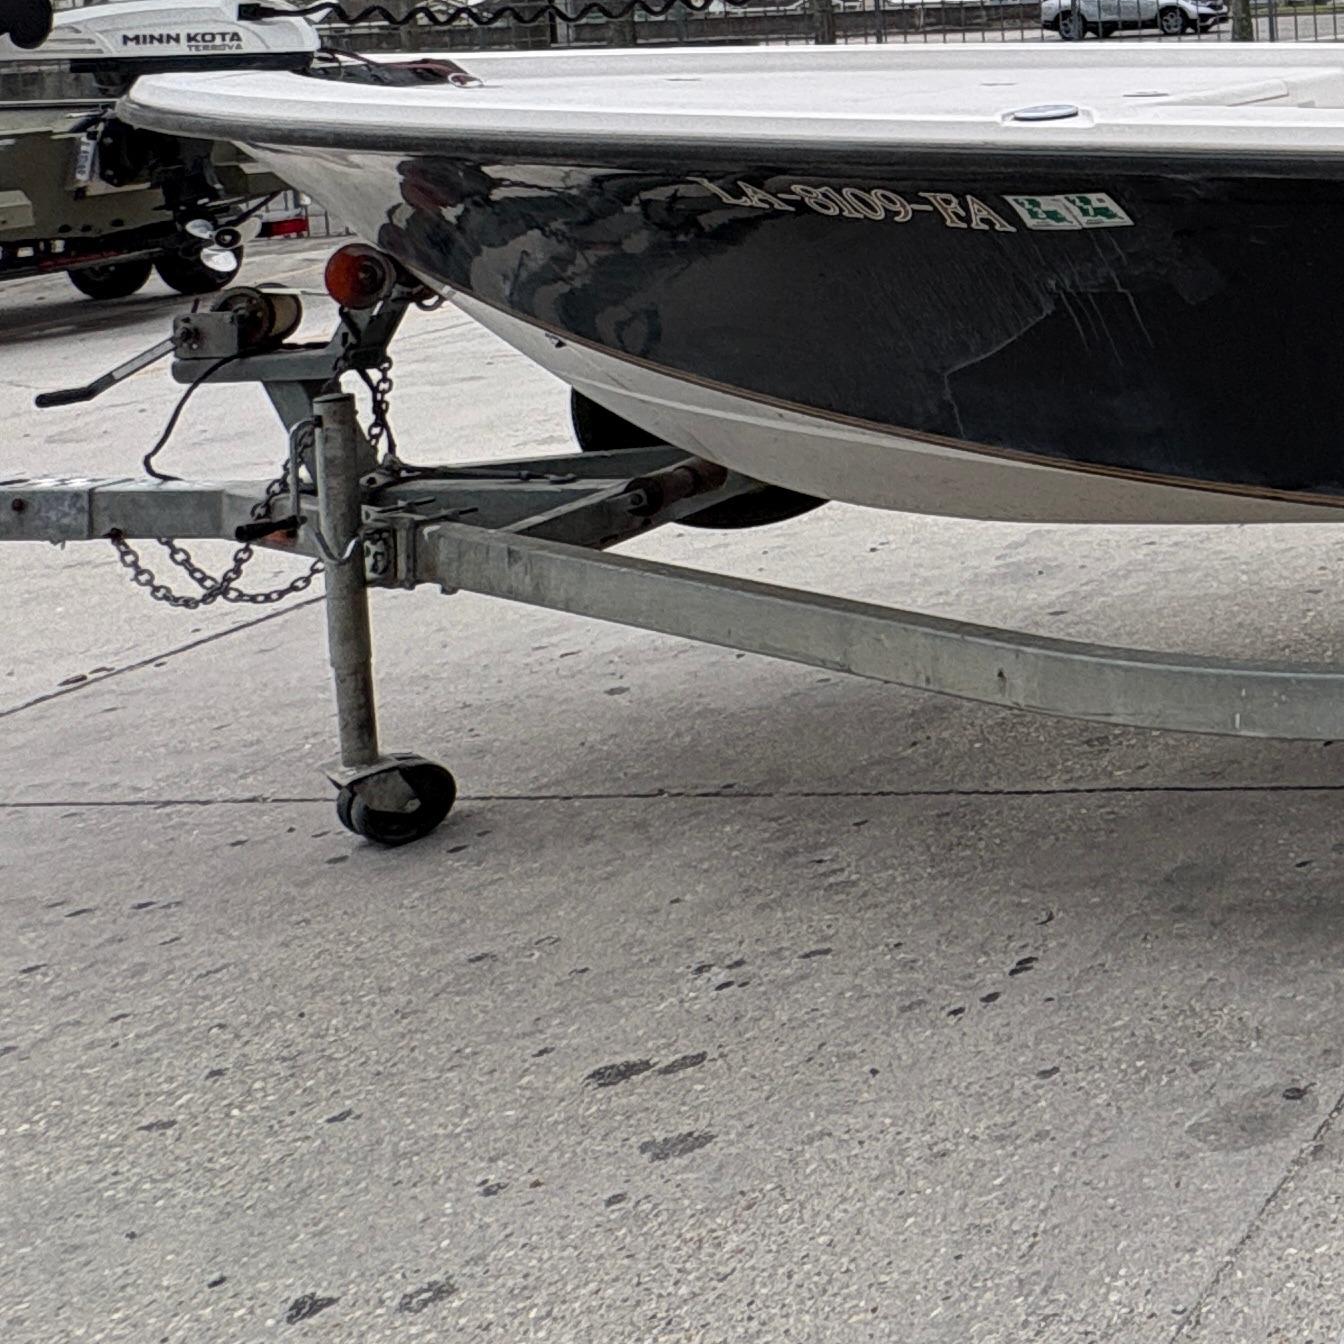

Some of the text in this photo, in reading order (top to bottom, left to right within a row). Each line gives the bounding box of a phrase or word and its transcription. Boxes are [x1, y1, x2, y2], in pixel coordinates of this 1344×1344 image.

[122, 31, 243, 46] MINN KOTA
[685, 176, 1017, 233] LA-8109-FA
